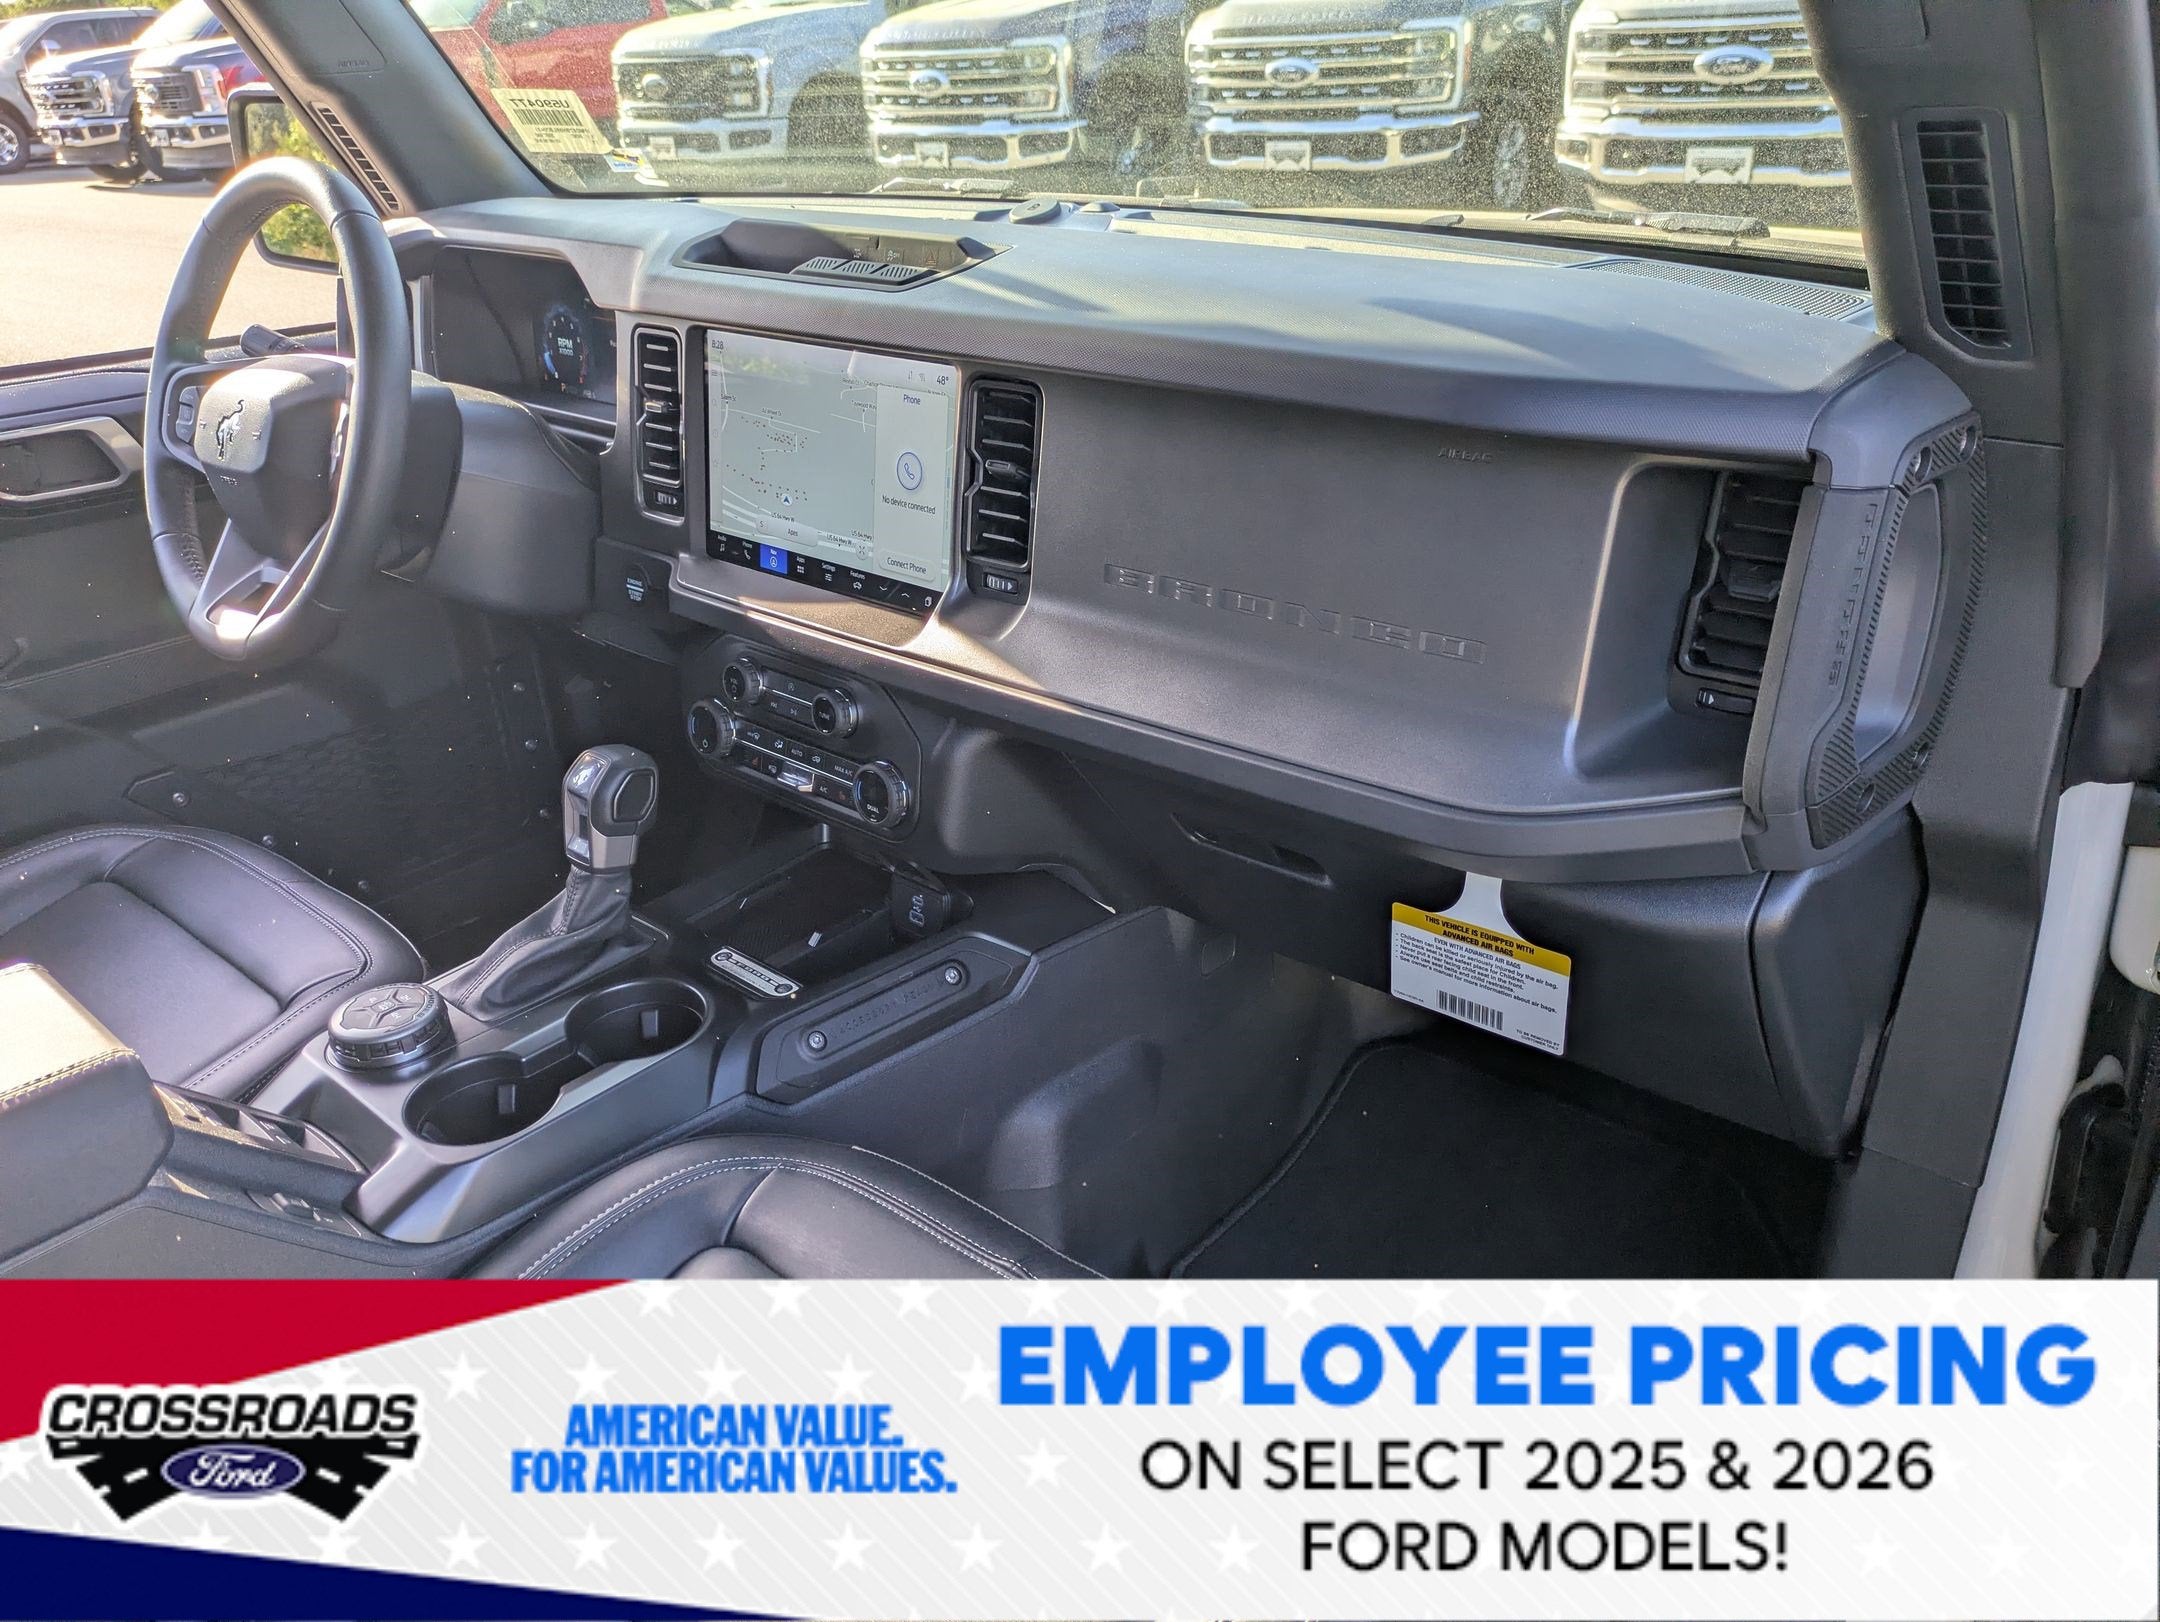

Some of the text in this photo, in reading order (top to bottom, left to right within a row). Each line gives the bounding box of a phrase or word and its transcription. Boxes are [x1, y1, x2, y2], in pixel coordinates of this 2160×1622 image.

[557, 337, 573, 349] RPM
[711, 339, 724, 350] 8:28
[936, 375, 949, 386] 48°
[903, 394, 921, 406] Phone
[882, 495, 936, 515] No device connected
[742, 541, 753, 549] Phone
[887, 557, 927, 575] Connect Phone
[627, 577, 643, 587] ENGINE
[628, 589, 643, 598] START
[630, 594, 642, 602] STOP
[1104, 562, 1487, 664] BRONCO
[791, 748, 803, 757] AUTO
[834, 765, 853, 777] MAX A/C
[820, 786, 828, 794] A/C
[866, 803, 879, 814] DUAL
[1425, 915, 1535, 955] THIS VEHICLE IS EQUIPPED WITH
[1442, 930, 1514, 957] ADVANCED AIR BAGS
[1434, 937, 1447, 946] EVEN
[1449, 942, 1464, 951] WITH
[1465, 946, 1493, 960] ADVANCED
[1506, 959, 1521, 969] BAGS
[1400, 938, 1411, 946] The
[1412, 942, 1424, 951] back
[1426, 947, 1437, 955] seat
[1445, 953, 1453, 961] the
[1455, 957, 1472, 967] safest
[1473, 962, 1489, 973] place
[1500, 971, 1526, 984] Children.
[1400, 933, 1423, 945] Children
[1424, 941, 1434, 949] can
[1444, 947, 1458, 957] killed
[1467, 955, 1493, 969] seriously
[1495, 963, 1515, 975] injured
[1517, 970, 1524, 979] by
[1525, 973, 1535, 982] the
[1545, 981, 1558, 990] bag.
[1400, 944, 1416, 953] Never
[1417, 950, 1426, 958] put
[1432, 955, 1442, 963] rear
[1444, 958, 1461, 970] facing
[1462, 965, 1476, 974] child
[1477, 970, 1489, 978] seat
[1508, 980, 1524, 990] front.
[1400, 950, 1419, 961] Always
[1432, 960, 1443, 968] seat
[1444, 964, 1457, 974] belts
[1459, 970, 1470, 978] and
[1471, 973, 1485, 983] child
[1486, 980, 1514, 993] restraints.
[1400, 955, 1410, 963] See
[1411, 960, 1432, 970] owner's
[1433, 966, 1453, 978] manual
[1463, 978, 1478, 987] more
[1479, 982, 1512, 999] information
[1514, 995, 1530, 1005] about
[1540, 1003, 1557, 1014] bags.
